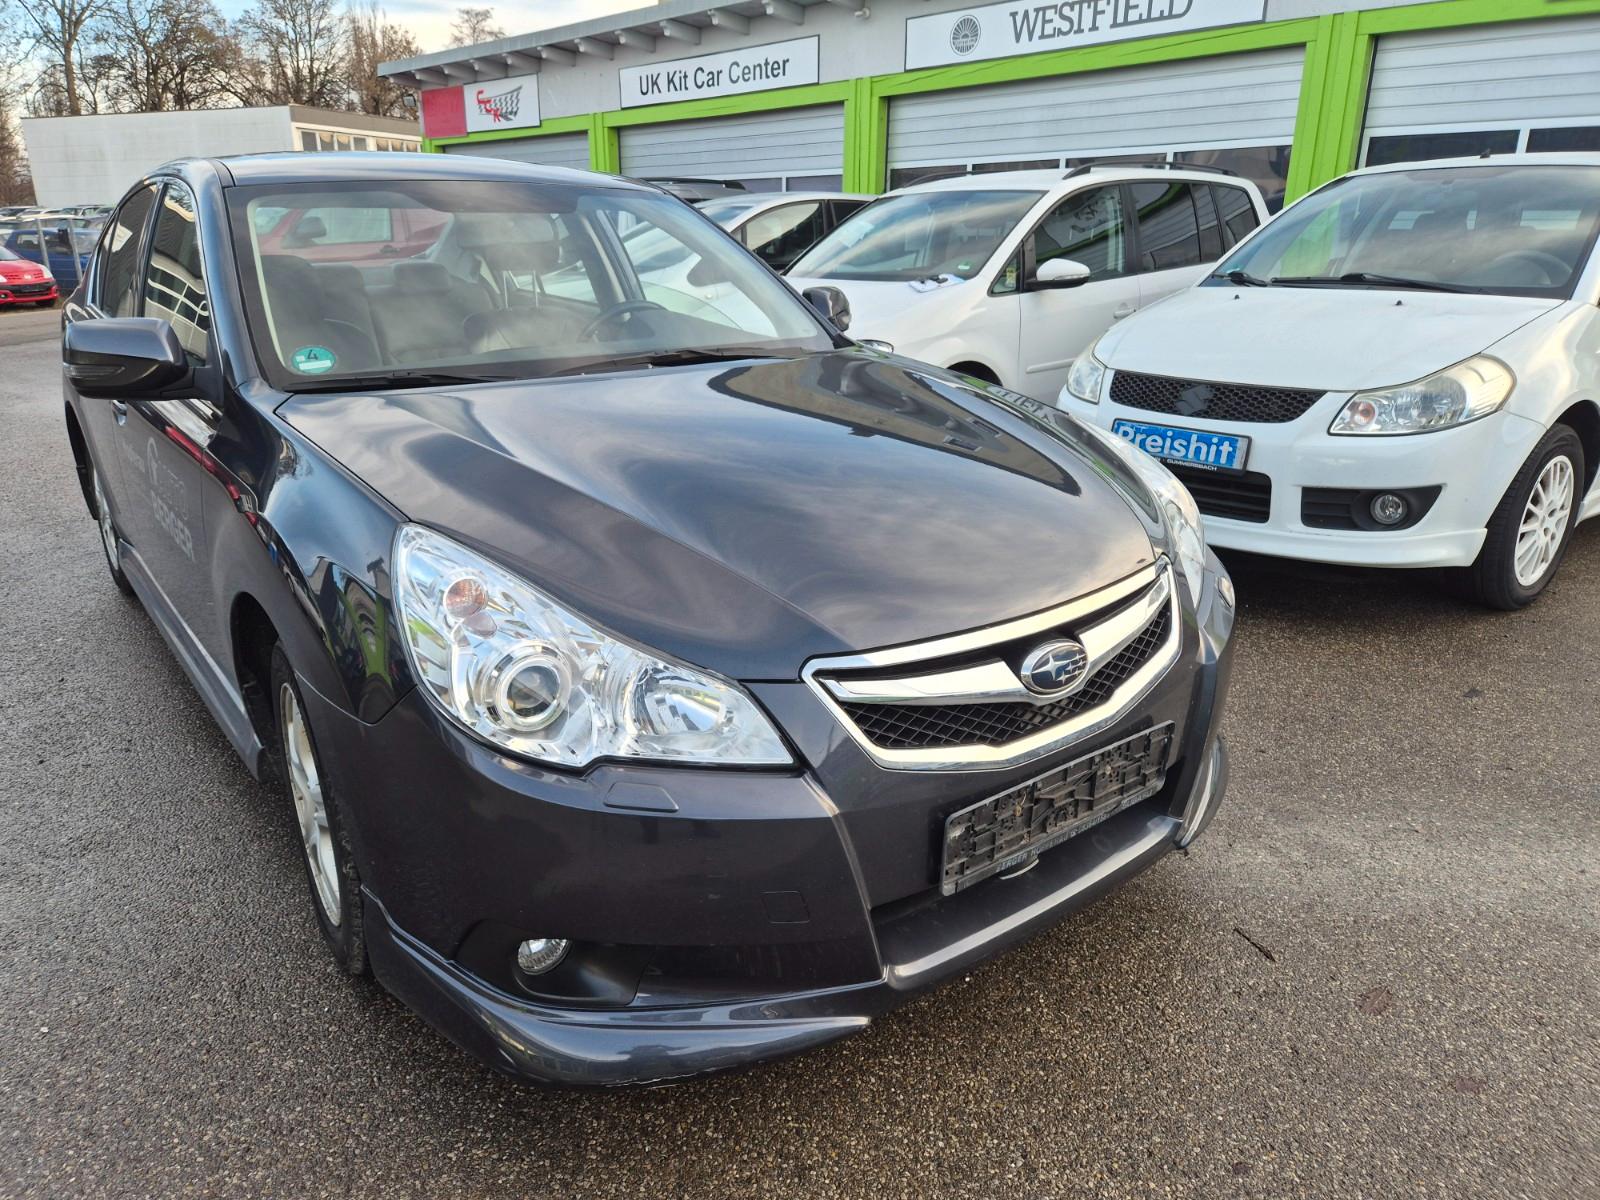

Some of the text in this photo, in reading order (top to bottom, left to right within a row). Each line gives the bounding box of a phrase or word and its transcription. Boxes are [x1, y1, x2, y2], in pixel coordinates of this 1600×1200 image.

[1009, 0, 1193, 44] WESTFIELD
[639, 56, 790, 96] UK Kit Car Center
[1118, 425, 1233, 465] Preishit
